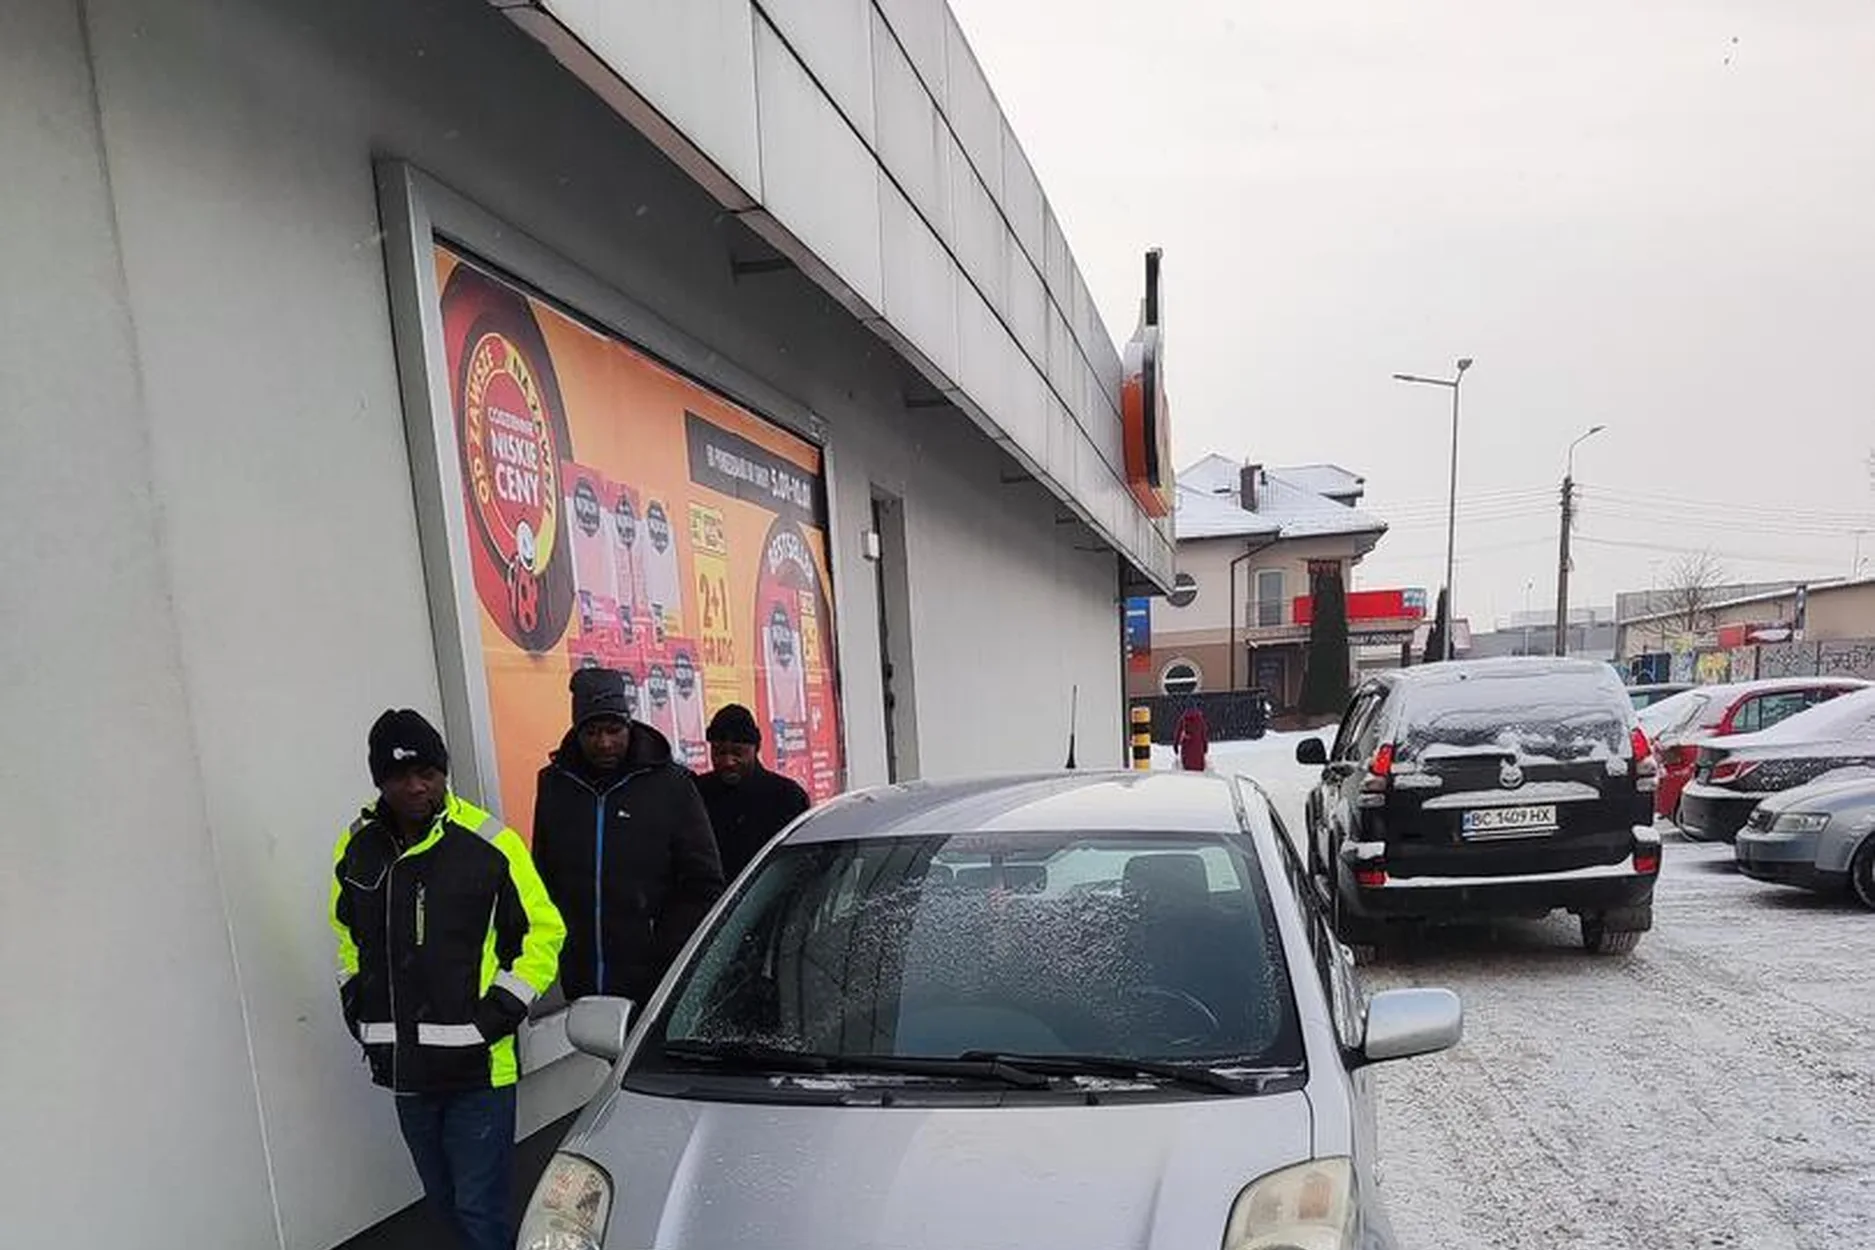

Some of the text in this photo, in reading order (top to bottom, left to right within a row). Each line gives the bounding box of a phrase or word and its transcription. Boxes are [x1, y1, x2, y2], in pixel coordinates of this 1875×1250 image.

[490, 428, 539, 469] NISKIE
[495, 462, 539, 508] CENY
[700, 573, 729, 631] 2+1
